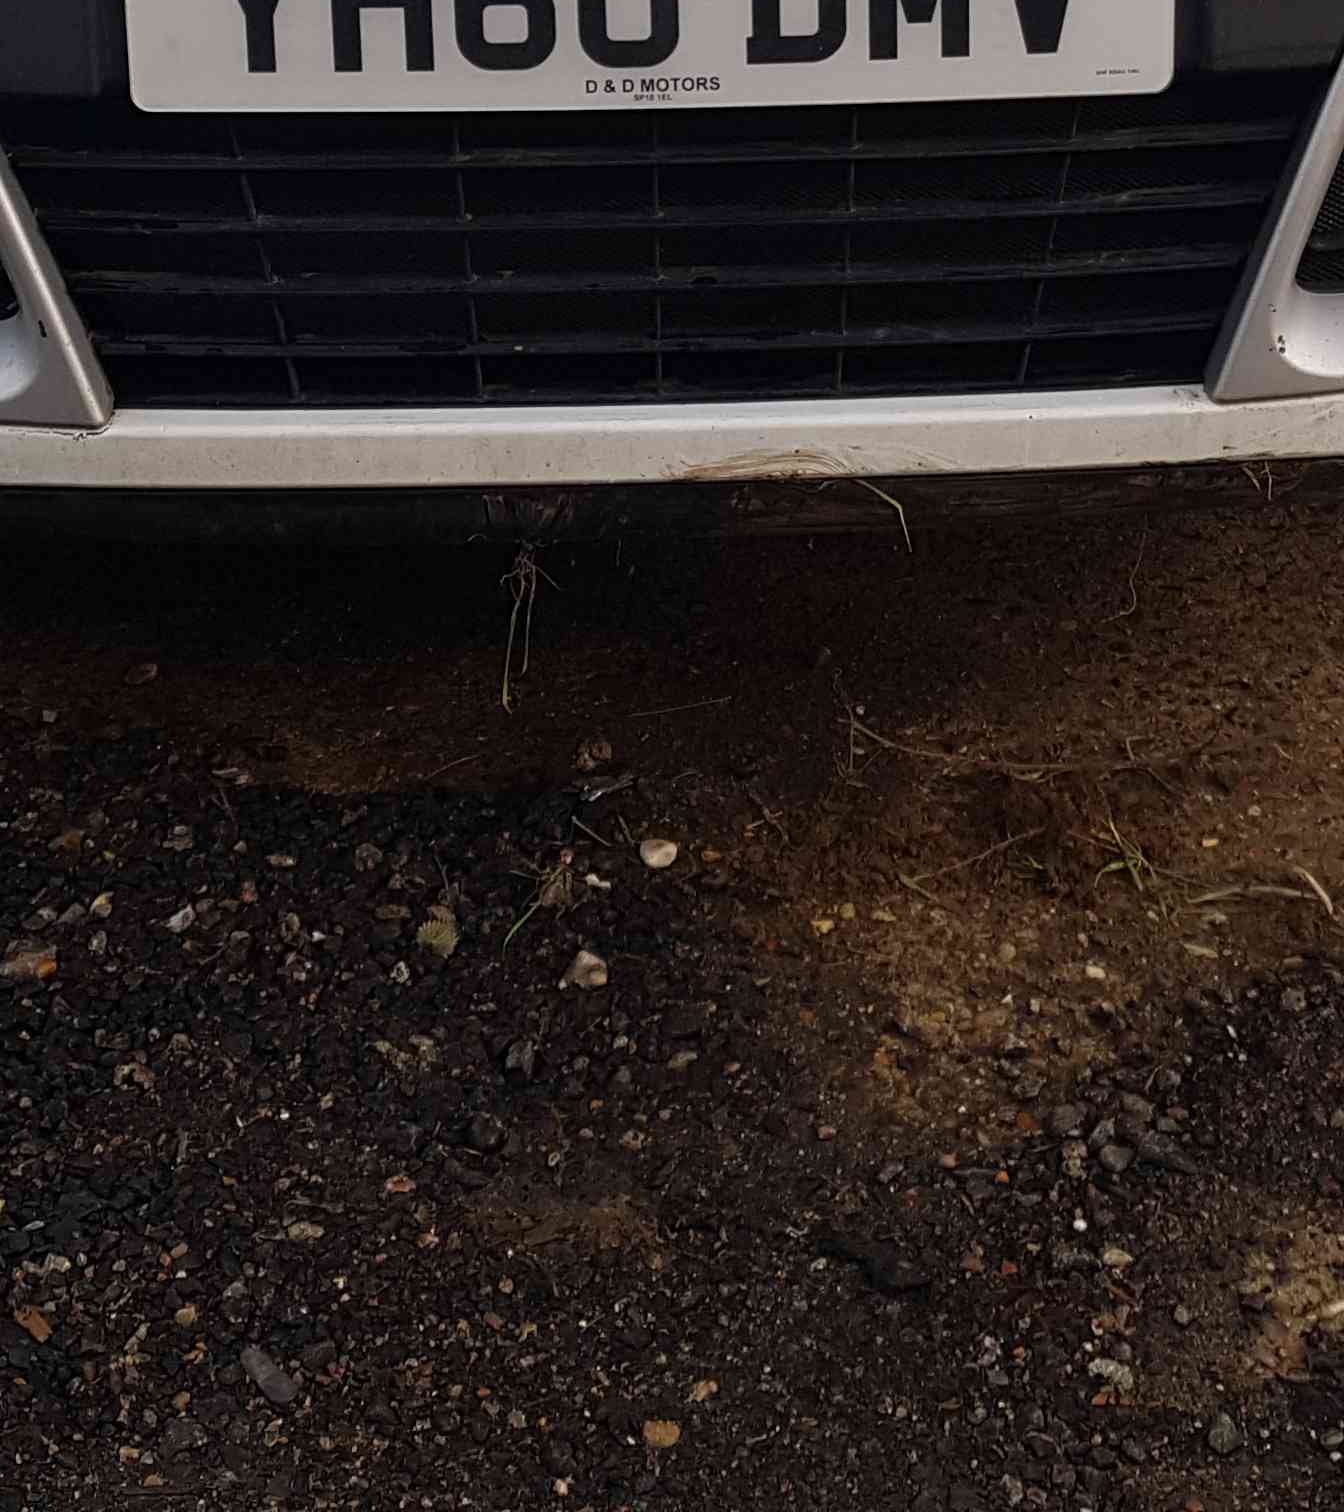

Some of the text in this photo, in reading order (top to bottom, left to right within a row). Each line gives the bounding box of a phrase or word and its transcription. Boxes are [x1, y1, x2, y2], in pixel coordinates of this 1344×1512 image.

[585, 76, 721, 94] D & D MOTORS
